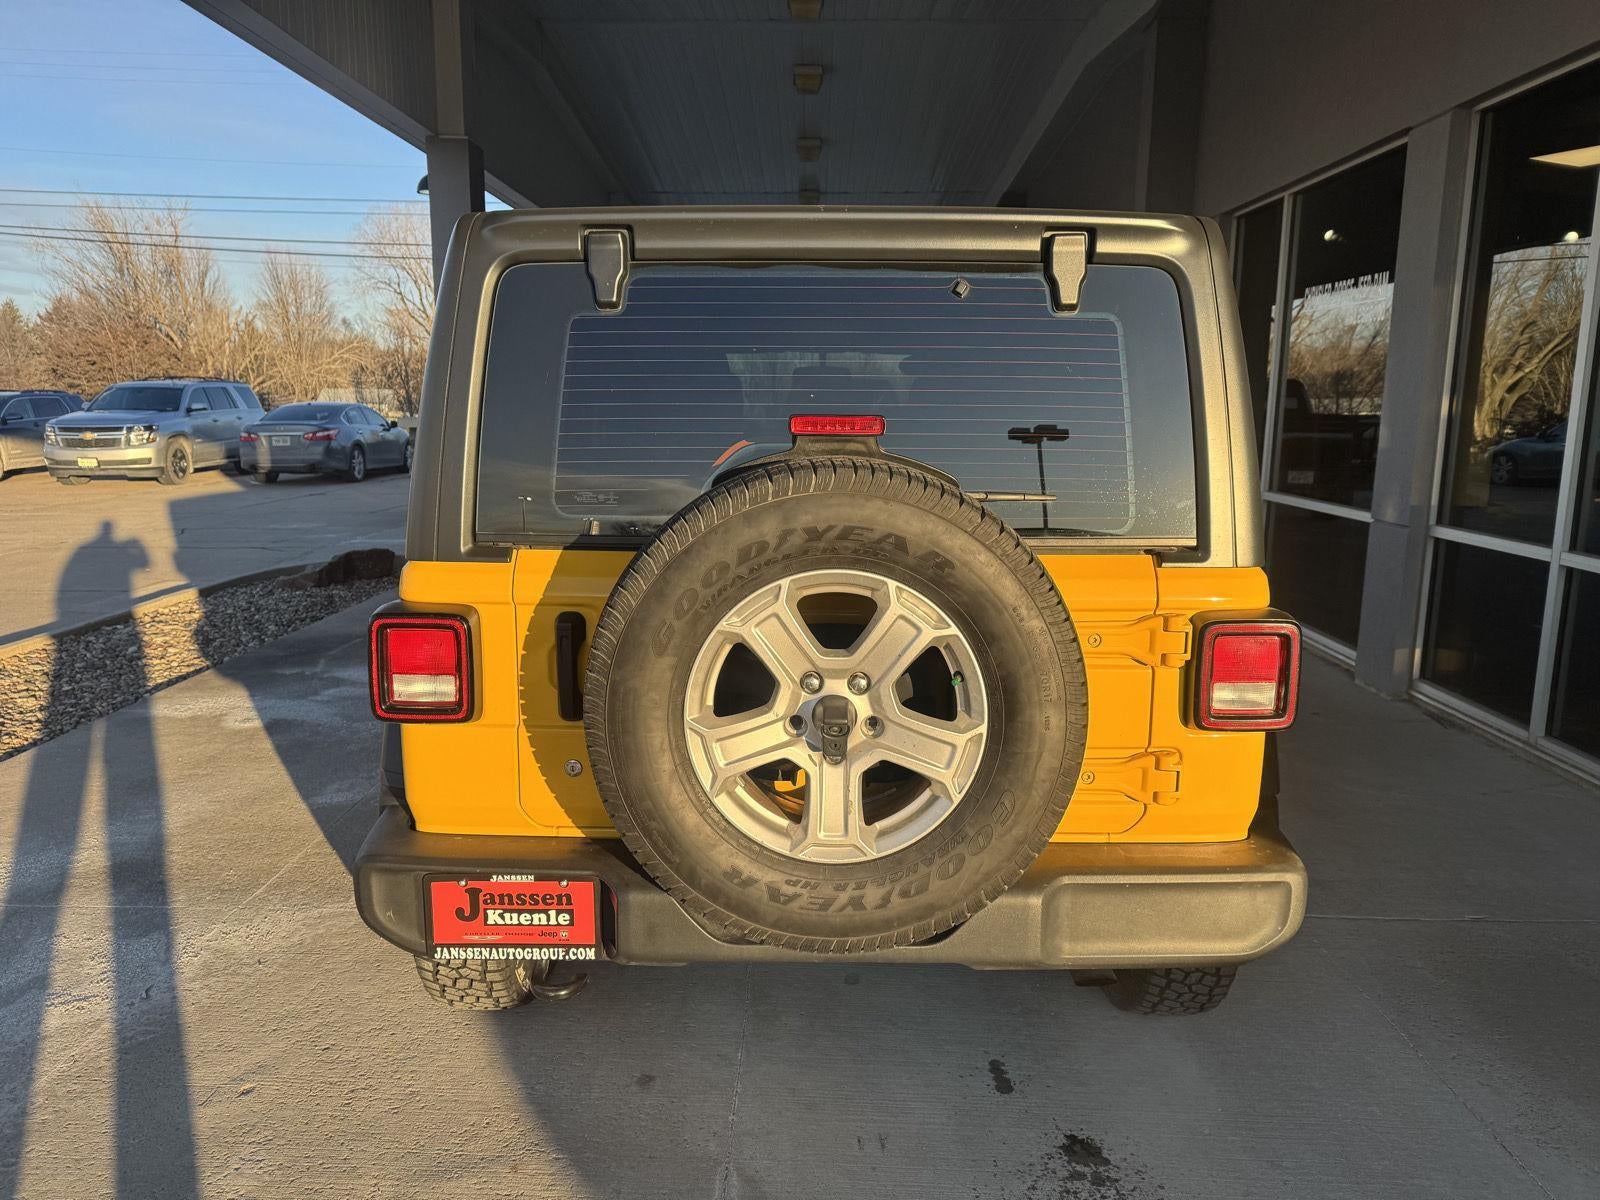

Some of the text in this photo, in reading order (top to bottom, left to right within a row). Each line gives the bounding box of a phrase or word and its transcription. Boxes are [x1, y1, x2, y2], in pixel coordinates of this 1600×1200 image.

[490, 875, 535, 883] JANSSEN
[455, 887, 573, 922] Janssen
[486, 909, 571, 925] Kuenle
[538, 930, 558, 939] Jeep
